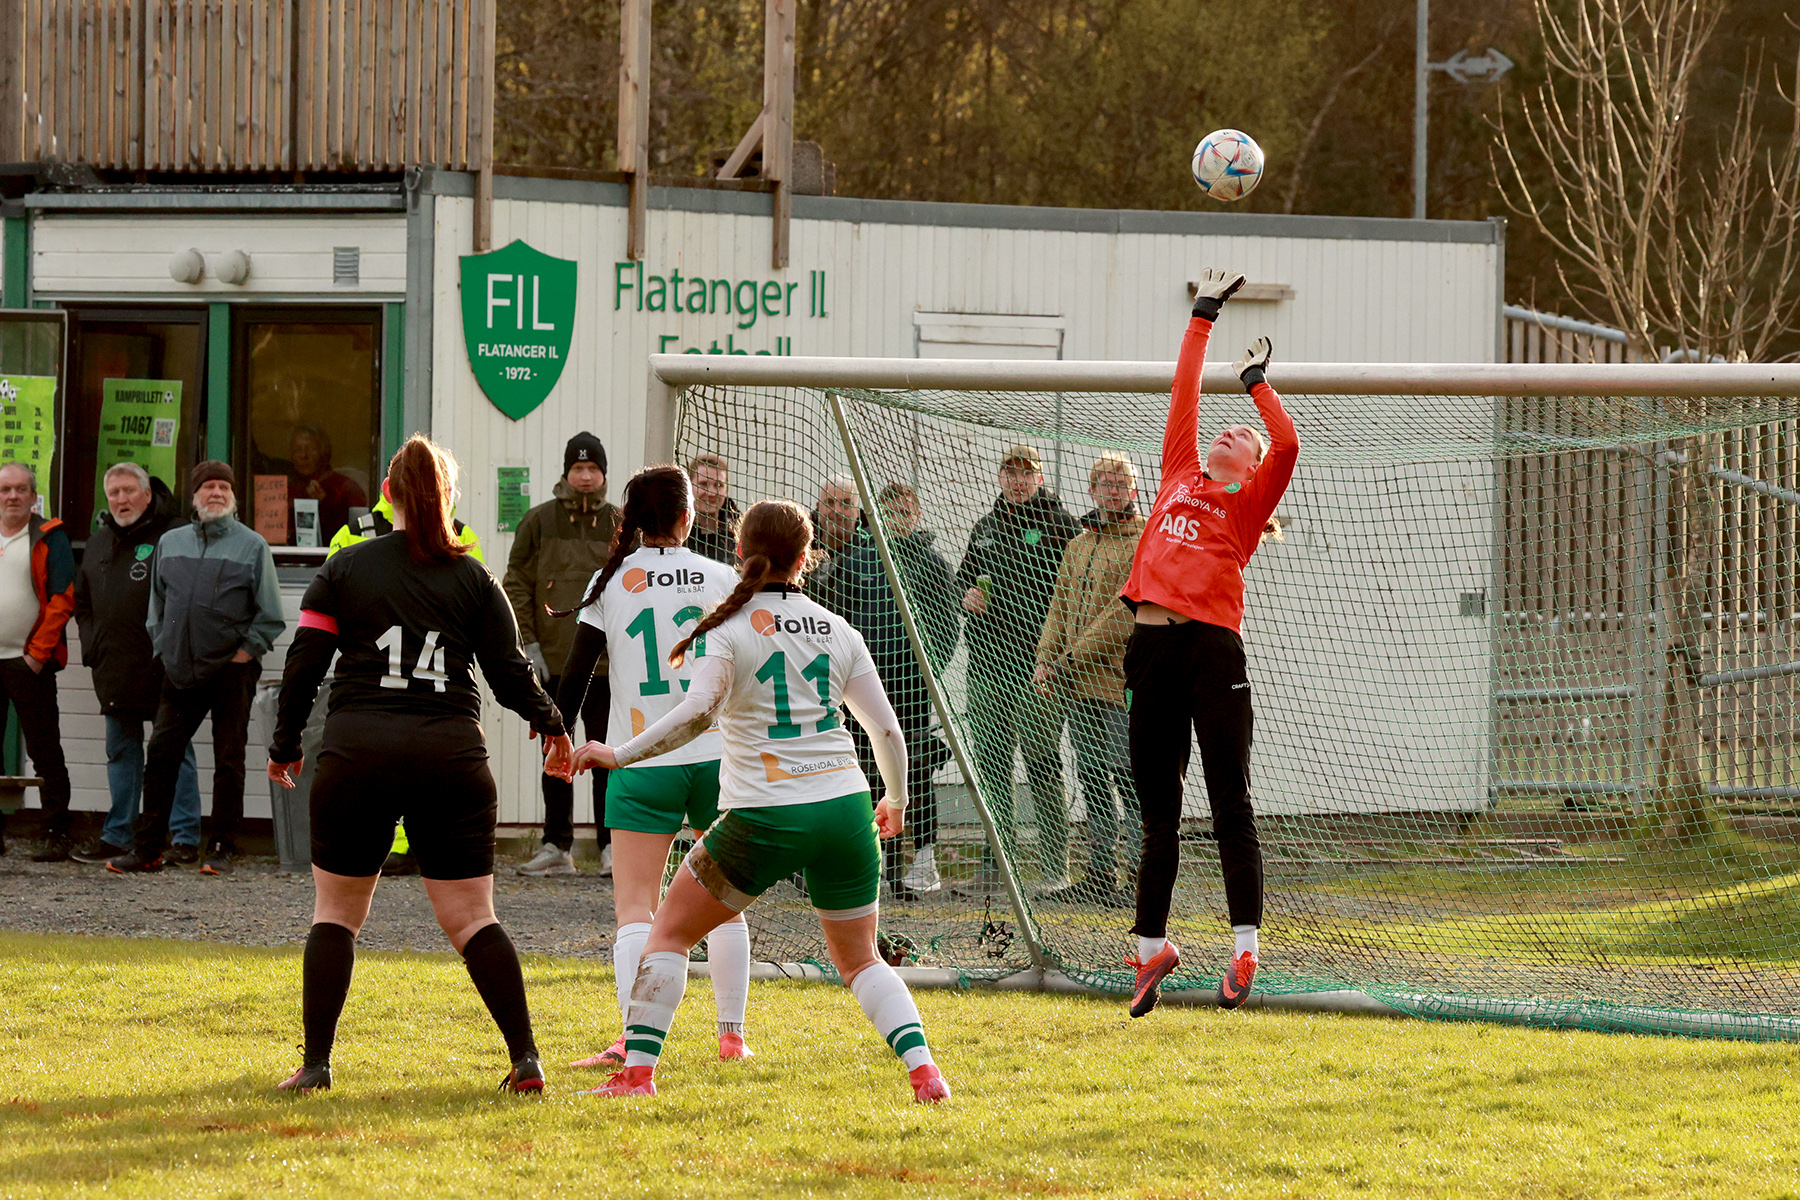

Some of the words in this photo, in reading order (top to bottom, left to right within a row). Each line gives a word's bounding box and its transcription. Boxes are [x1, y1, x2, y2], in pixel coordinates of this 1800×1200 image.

[486, 273, 556, 331] FIL
[615, 261, 798, 329] Flatanger
[478, 343, 546, 358] FLATANGER
[549, 346, 559, 359] IL
[505, 366, 531, 381] 1972
[115, 390, 163, 404] KAMPBILLETT
[121, 415, 152, 435] 11467
[1213, 507, 1227, 519] AS
[1159, 513, 1201, 541] AQS
[646, 568, 705, 588] folla
[692, 585, 705, 593] BÅT
[774, 615, 831, 635] folla
[375, 625, 450, 693] 14
[755, 651, 842, 740] 11
[791, 760, 837, 774] ROSENDAL
